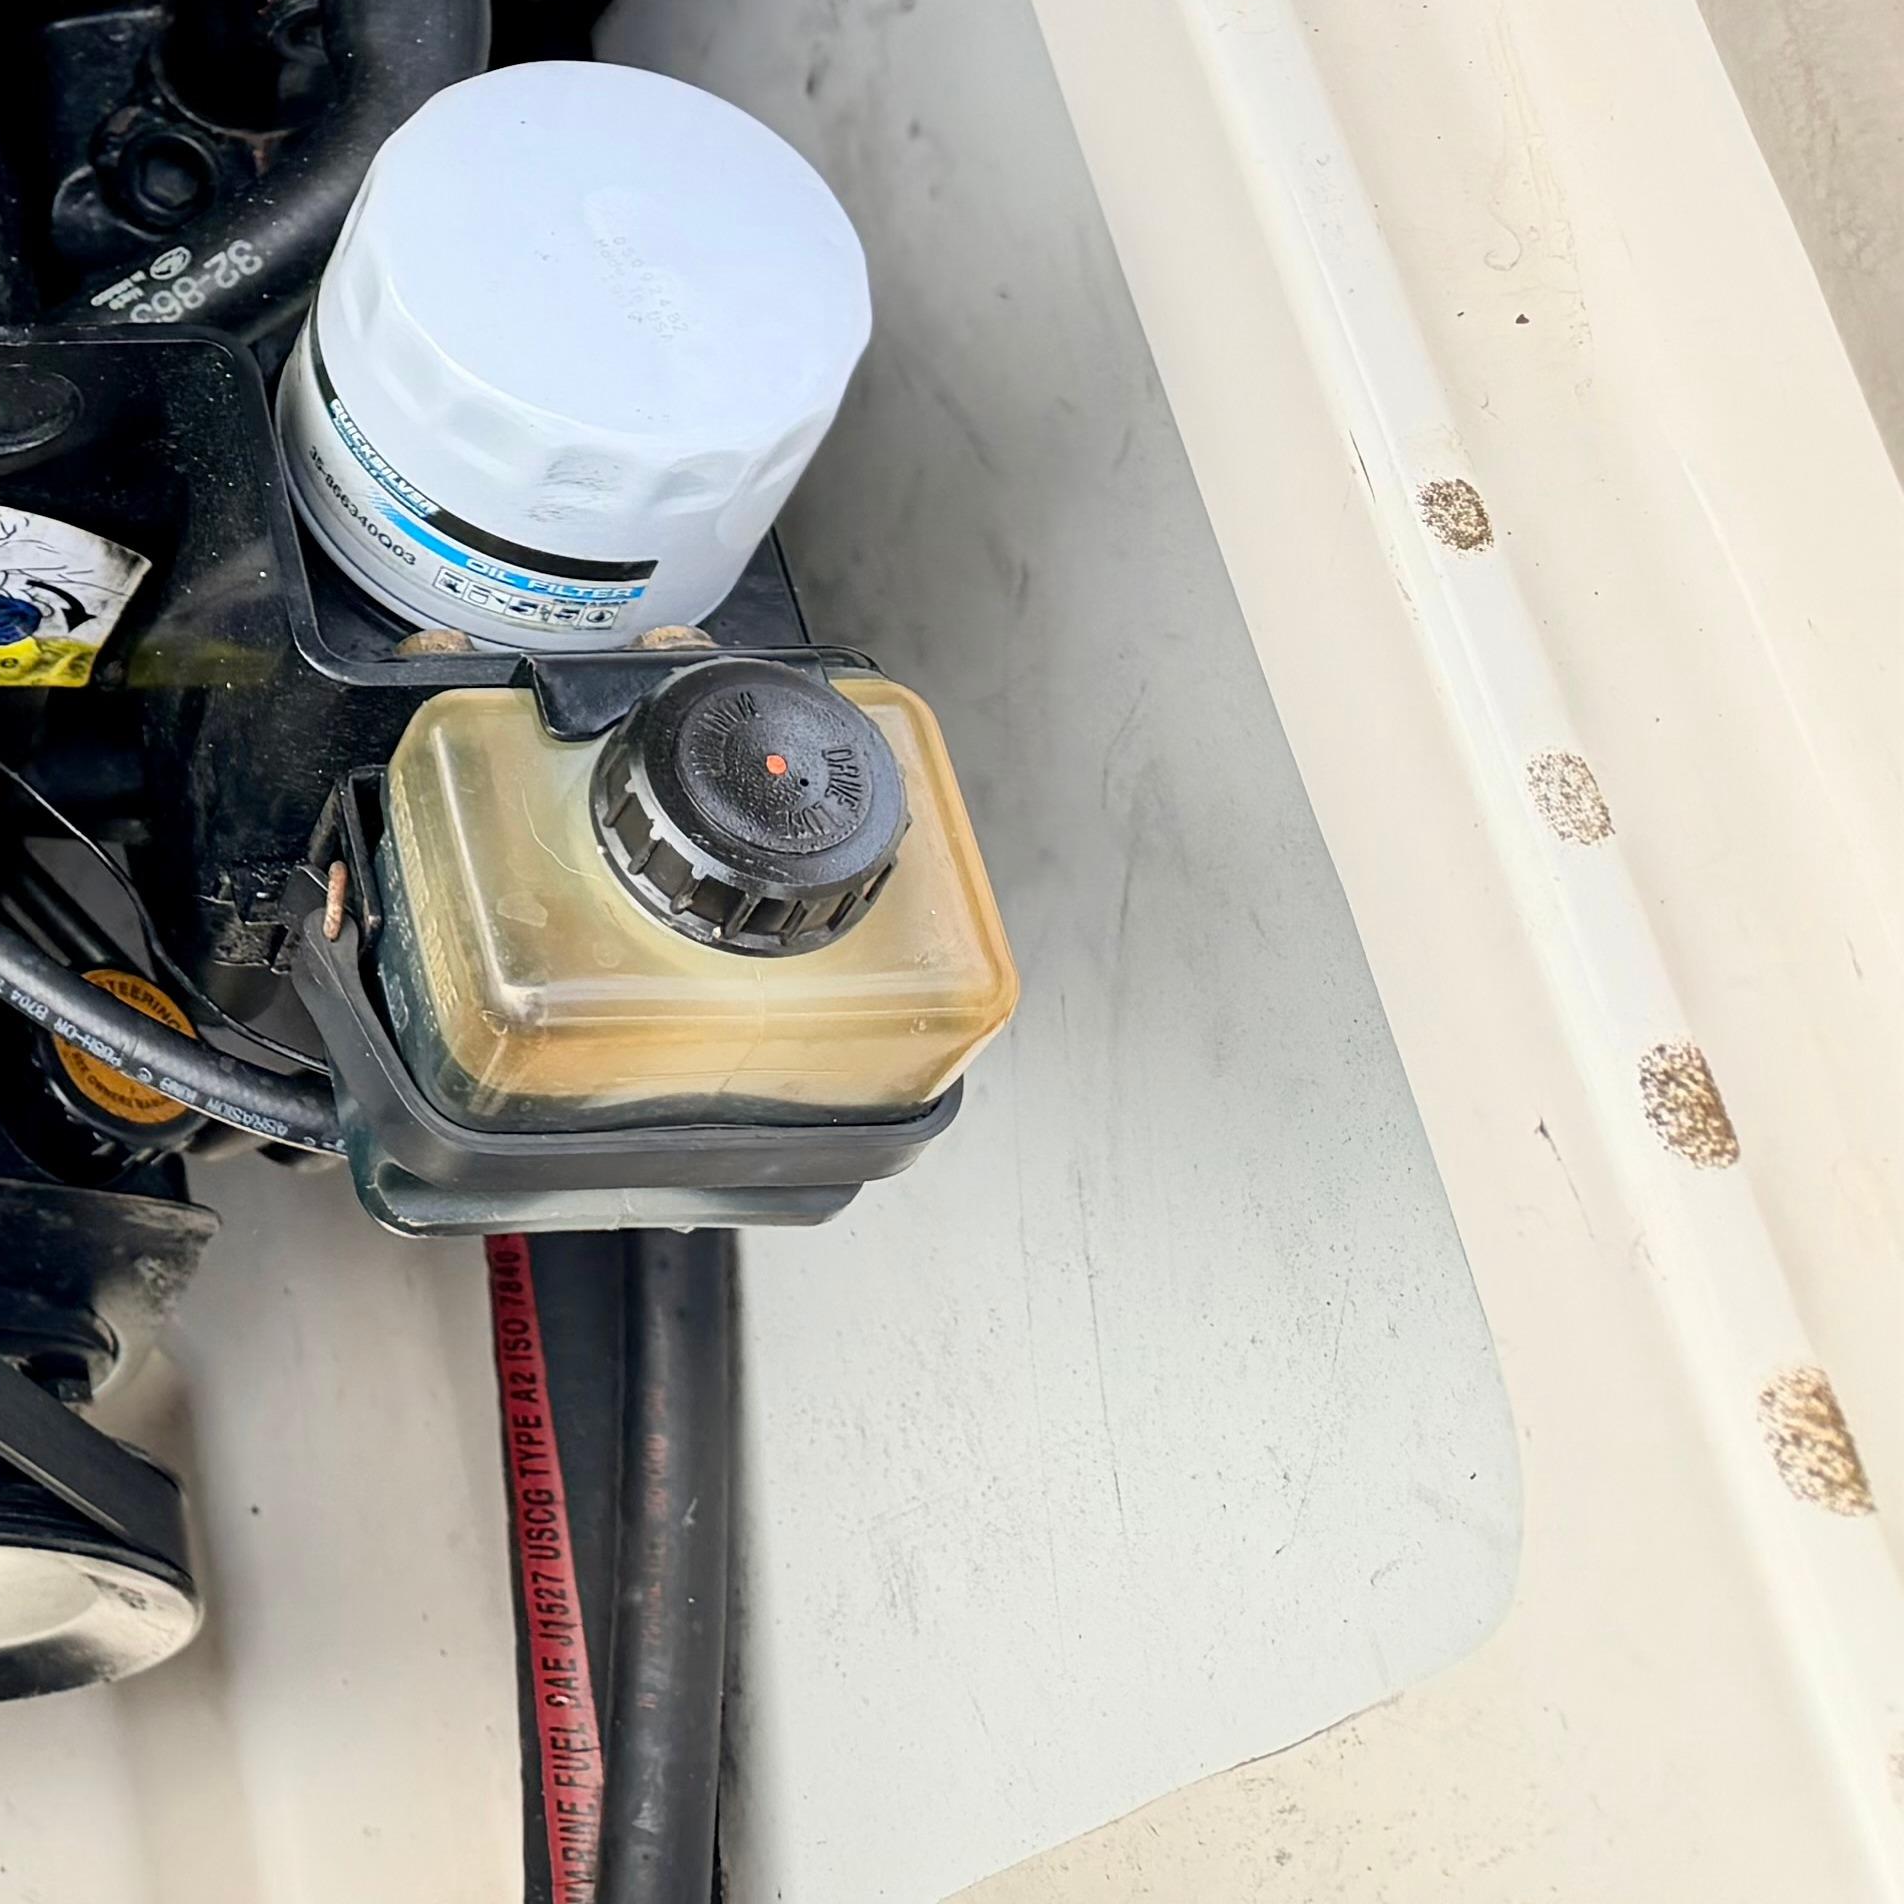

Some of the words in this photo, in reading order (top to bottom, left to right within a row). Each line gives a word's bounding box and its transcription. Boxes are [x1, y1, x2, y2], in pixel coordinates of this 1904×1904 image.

[466, 558, 515, 584] OIL
[528, 580, 632, 598] FILTER
[822, 748, 863, 810] DRIVE
[494, 1250, 525, 1307] 7840
[501, 1318, 533, 1360] ISO
[510, 1371, 538, 1403] A2
[513, 1415, 551, 1479] TYPE
[524, 1489, 561, 1560] USCG
[531, 1571, 578, 1647] J1527
[544, 1657, 580, 1708] SAE
[550, 1722, 592, 1788] FUEL
